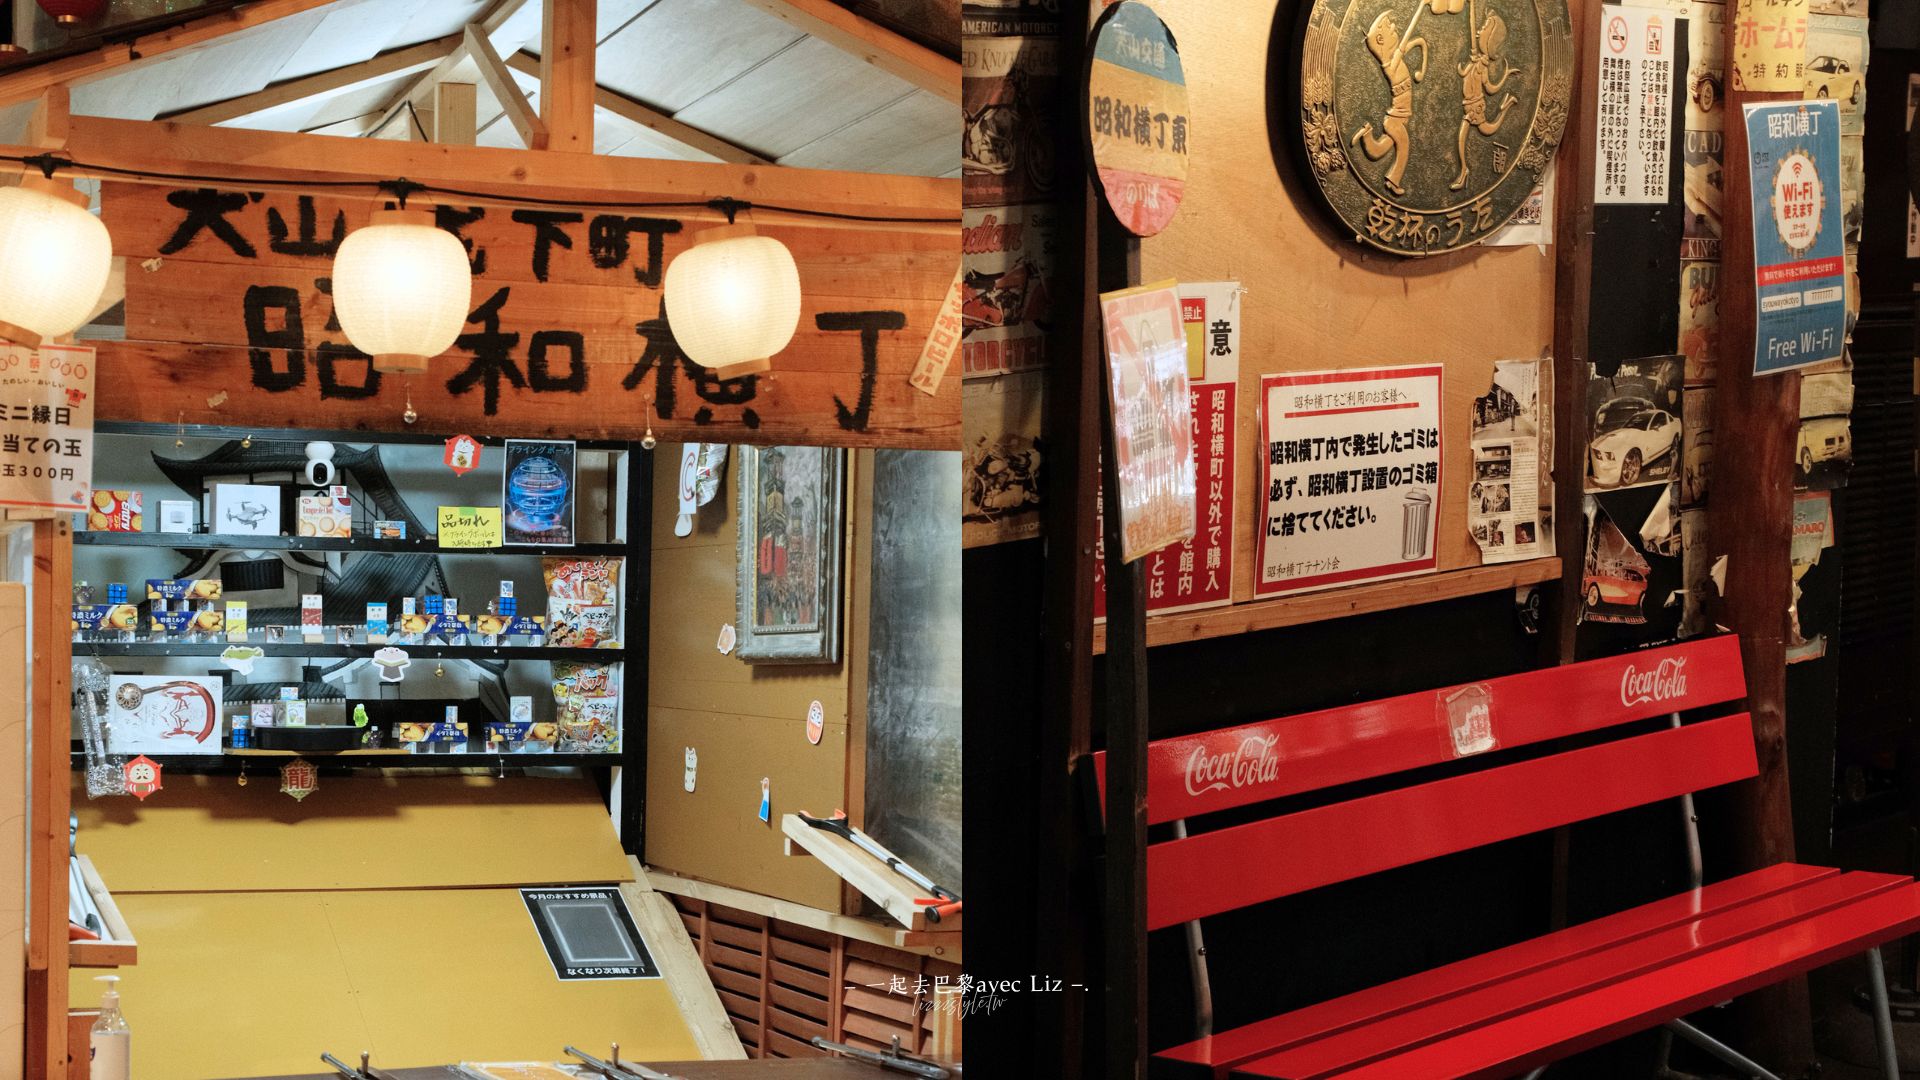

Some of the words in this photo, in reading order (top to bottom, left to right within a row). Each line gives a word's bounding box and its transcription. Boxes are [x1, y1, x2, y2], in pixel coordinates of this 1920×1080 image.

[1094, 96, 1187, 155] 昭和横丁東
[1767, 111, 1822, 139] 昭和横丁
[1782, 182, 1813, 202] Wi-Fi
[158, 189, 681, 289] 犬山下町
[1364, 197, 1494, 247] 乾杯のうた
[1768, 337, 1797, 360] Free
[1801, 327, 1834, 354] Wi-Fi
[1294, 388, 1408, 409] 昭和横丁をご利用のお客様へ
[1270, 427, 1438, 466] 昭和横丁内で発生したゴミは
[1206, 389, 1226, 592] 昭和横町以外で購入
[1270, 461, 1438, 502] 必ず、昭和横丁設置のゴミ箱
[441, 514, 490, 528] 品切れ
[1267, 504, 1377, 537] に捨ててください。
[1266, 557, 1341, 578] 昭和横丁テナント会
[1620, 656, 1687, 707] Coca-Cola
[1185, 733, 1280, 797] Coca-Cola
